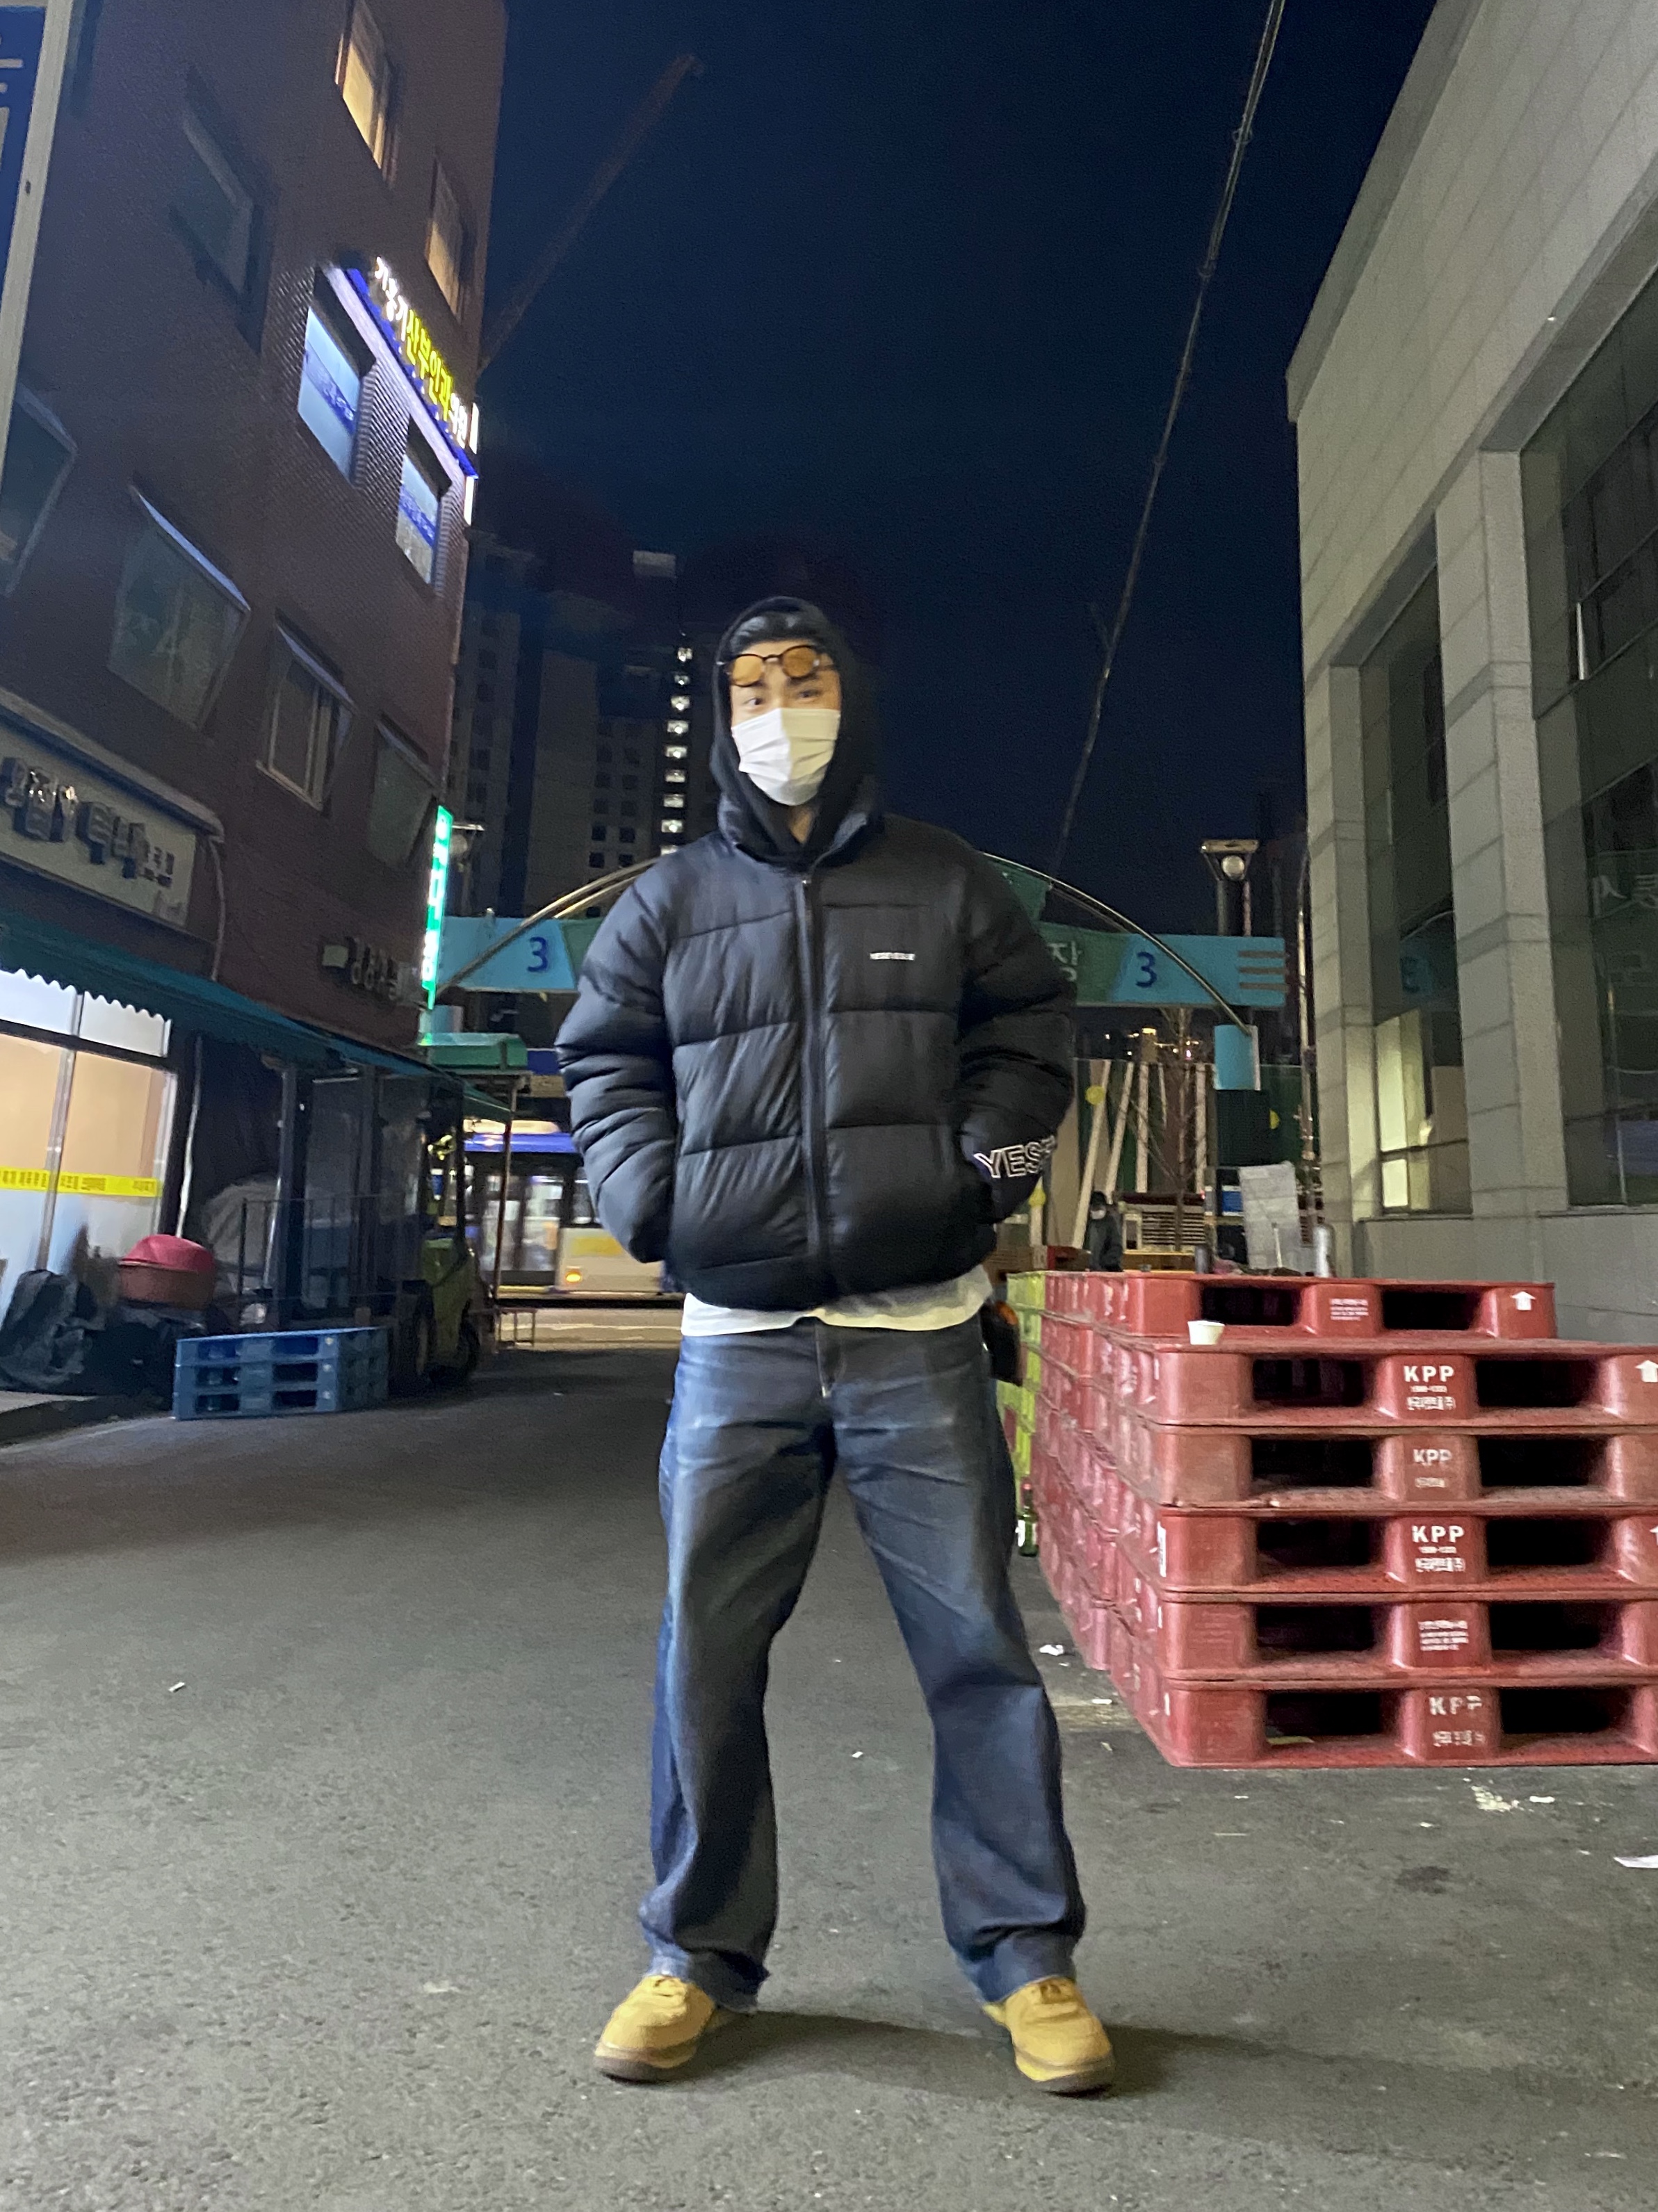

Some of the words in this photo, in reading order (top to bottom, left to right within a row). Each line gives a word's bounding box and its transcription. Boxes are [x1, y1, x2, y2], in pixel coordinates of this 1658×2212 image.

[526, 936, 548, 973] 3
[1135, 951, 1157, 988] 3
[973, 1135, 1056, 1178] YES
[1404, 1365, 1454, 1382] KPP
[1413, 1449, 1452, 1464] KPP
[1411, 1525, 1465, 1543] KPP
